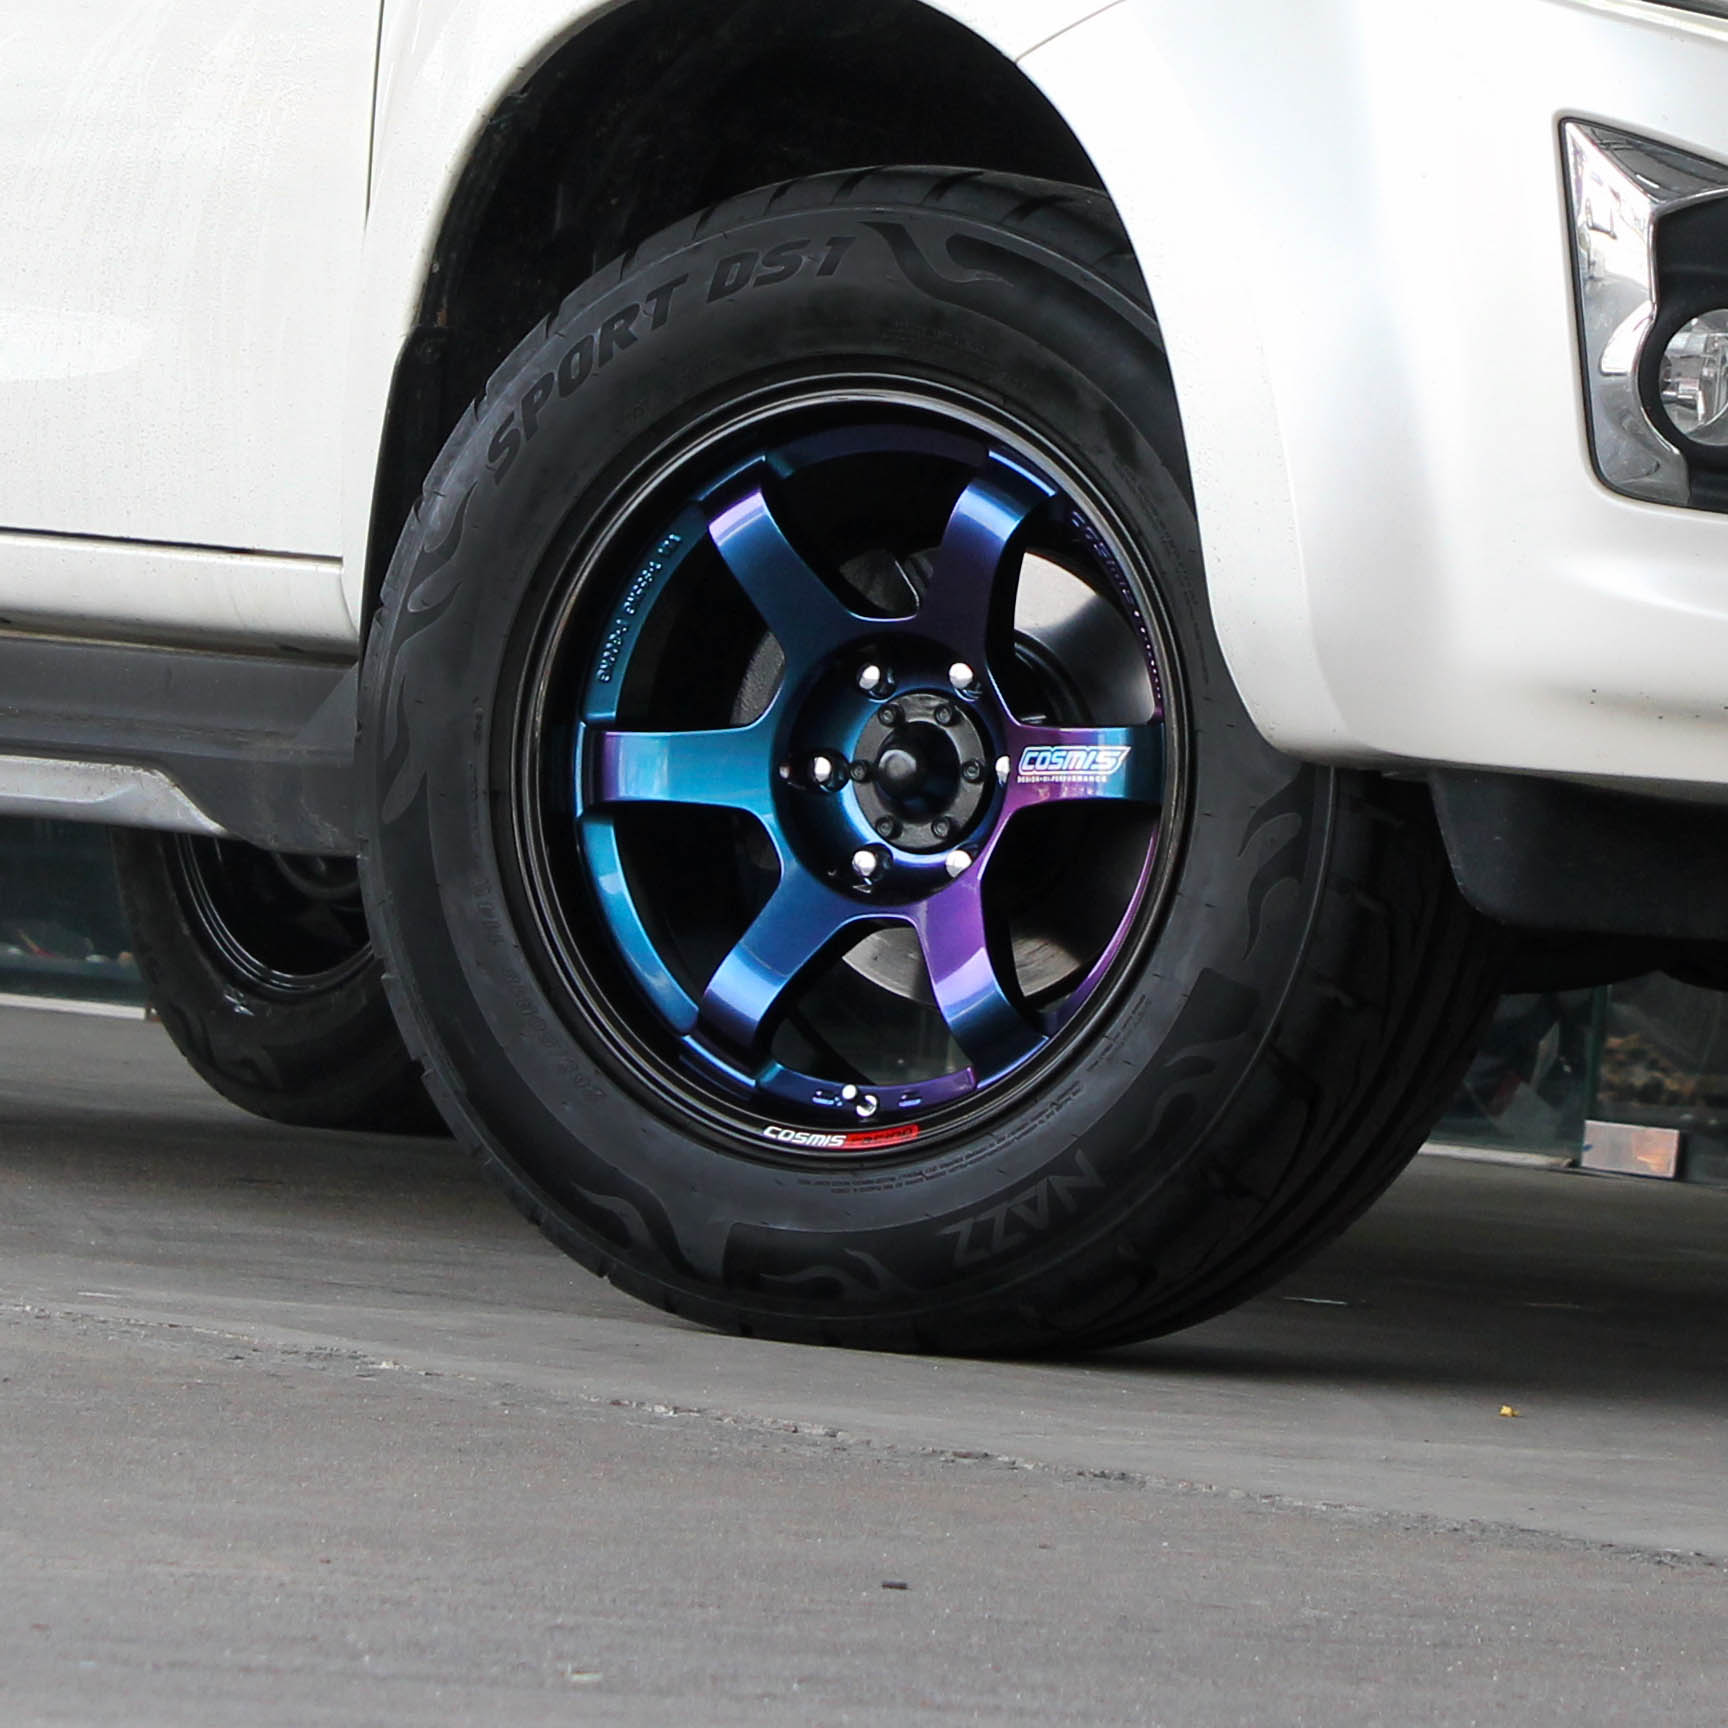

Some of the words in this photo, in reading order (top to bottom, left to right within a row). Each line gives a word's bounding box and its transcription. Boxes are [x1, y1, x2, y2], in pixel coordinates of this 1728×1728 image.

[486, 273, 689, 486] SPORT
[1021, 750, 1122, 771] COSMIS
[762, 1125, 847, 1147] COSMIS
